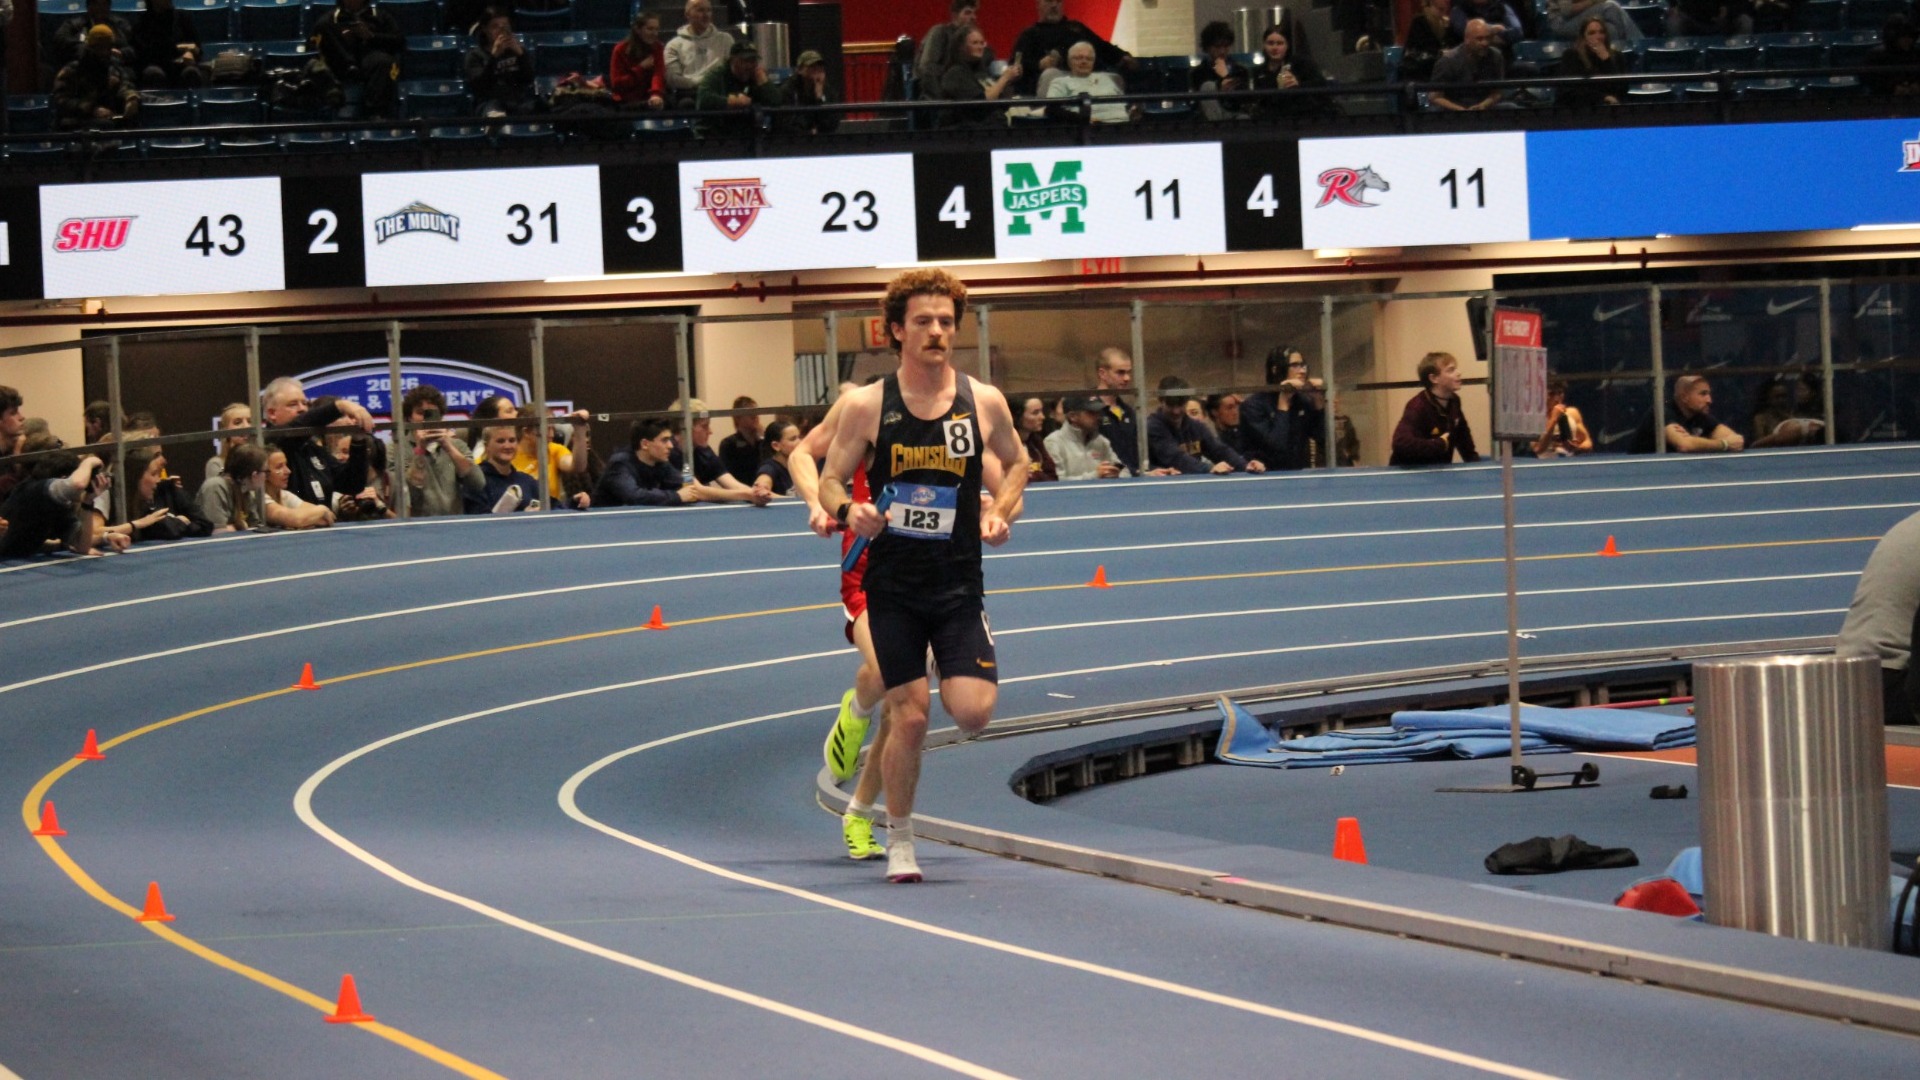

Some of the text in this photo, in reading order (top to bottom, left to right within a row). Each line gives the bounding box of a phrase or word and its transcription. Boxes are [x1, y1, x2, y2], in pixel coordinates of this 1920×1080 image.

[700, 187, 766, 207] IONA
[938, 185, 971, 229] 4
[1008, 186, 1083, 211] JASPERS
[1135, 178, 1181, 221] 11
[1246, 173, 1279, 218] 4
[1439, 167, 1485, 209] 11
[307, 208, 339, 254] 2
[375, 211, 460, 244] THE MOUNT
[506, 202, 559, 246] 31
[626, 197, 657, 242] 3
[821, 190, 878, 233] 23
[54, 217, 131, 251] SHU
[185, 214, 246, 257] 43
[948, 422, 971, 455] 8
[903, 508, 940, 530] 123
